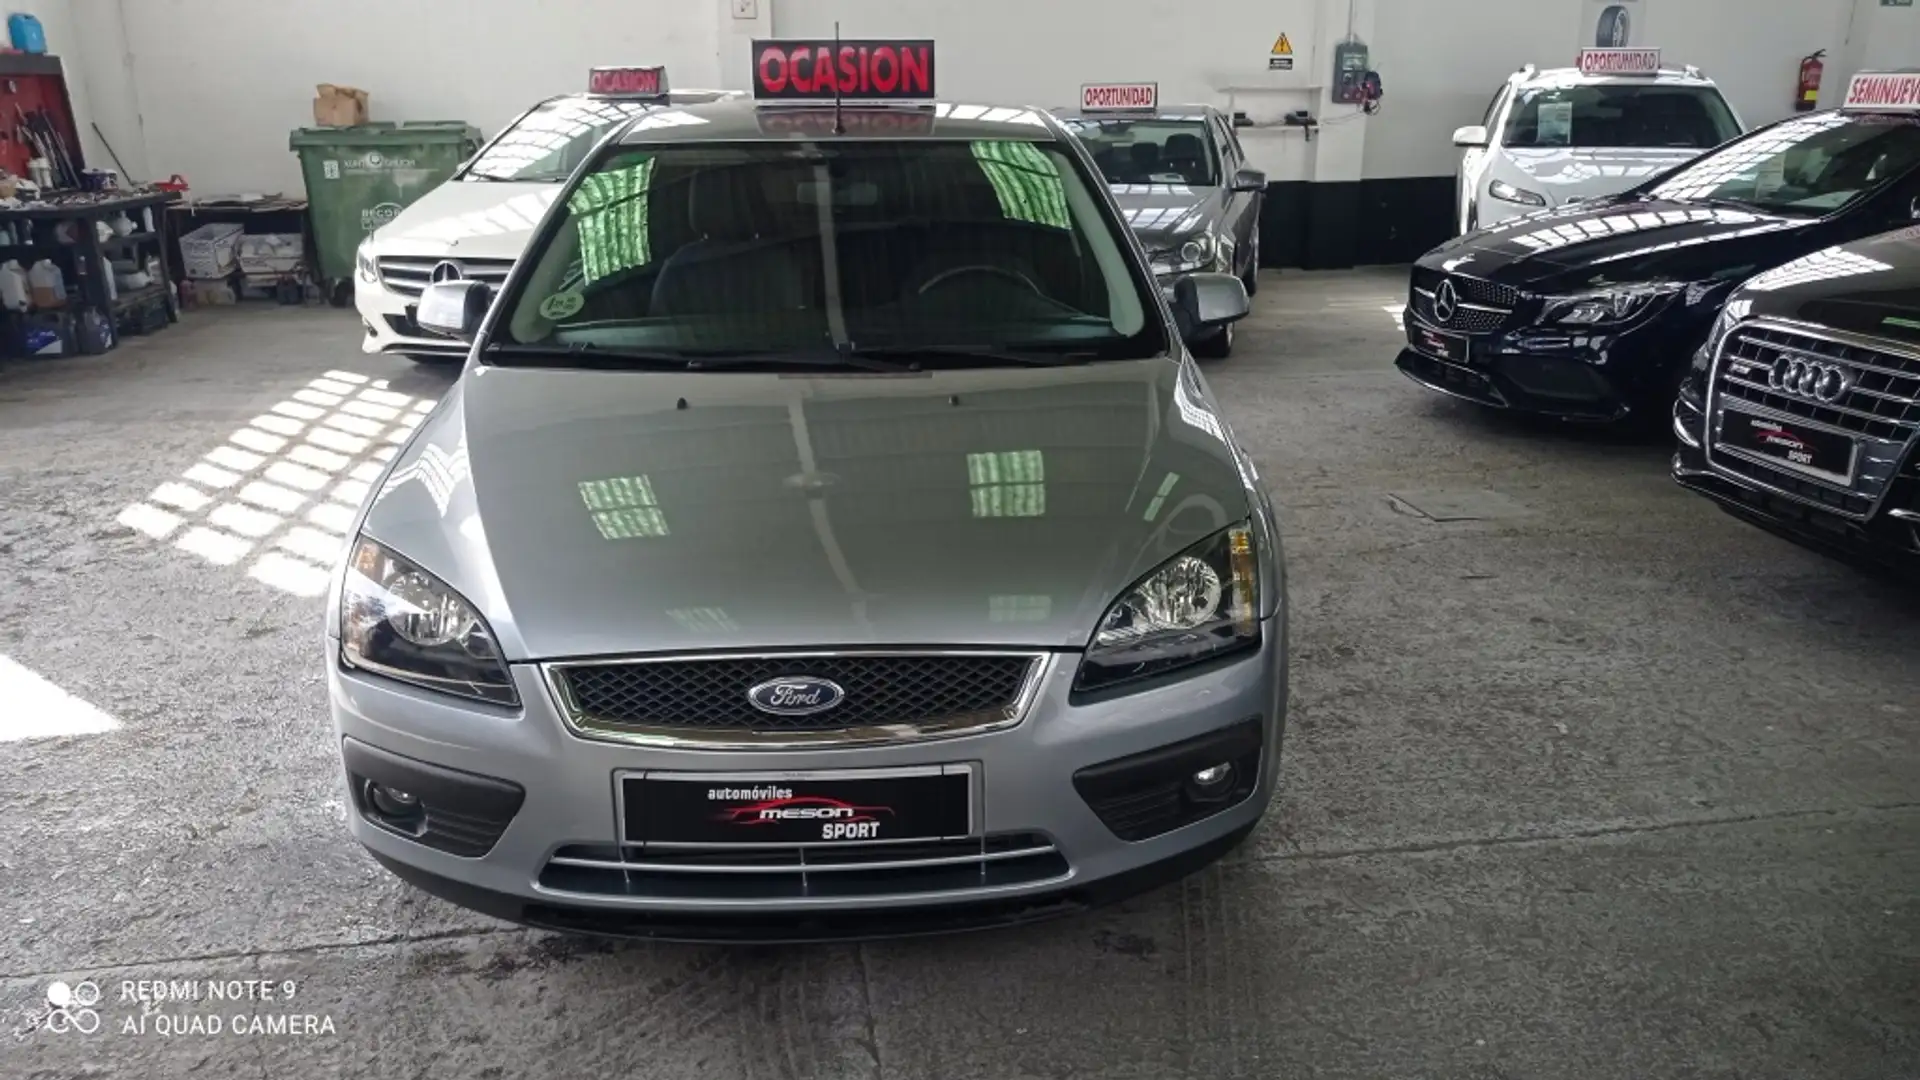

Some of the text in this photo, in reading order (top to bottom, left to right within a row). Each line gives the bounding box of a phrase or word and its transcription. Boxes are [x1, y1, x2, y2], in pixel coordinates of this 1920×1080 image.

[759, 46, 928, 92] OCASION
[1584, 53, 1655, 70] OPORTUNIDAD
[591, 70, 657, 92] OCASION
[1084, 87, 1153, 106] OPORTUNIDAD
[770, 684, 821, 705] Ford
[707, 785, 793, 800] automóviles
[822, 821, 880, 839] SPORT
